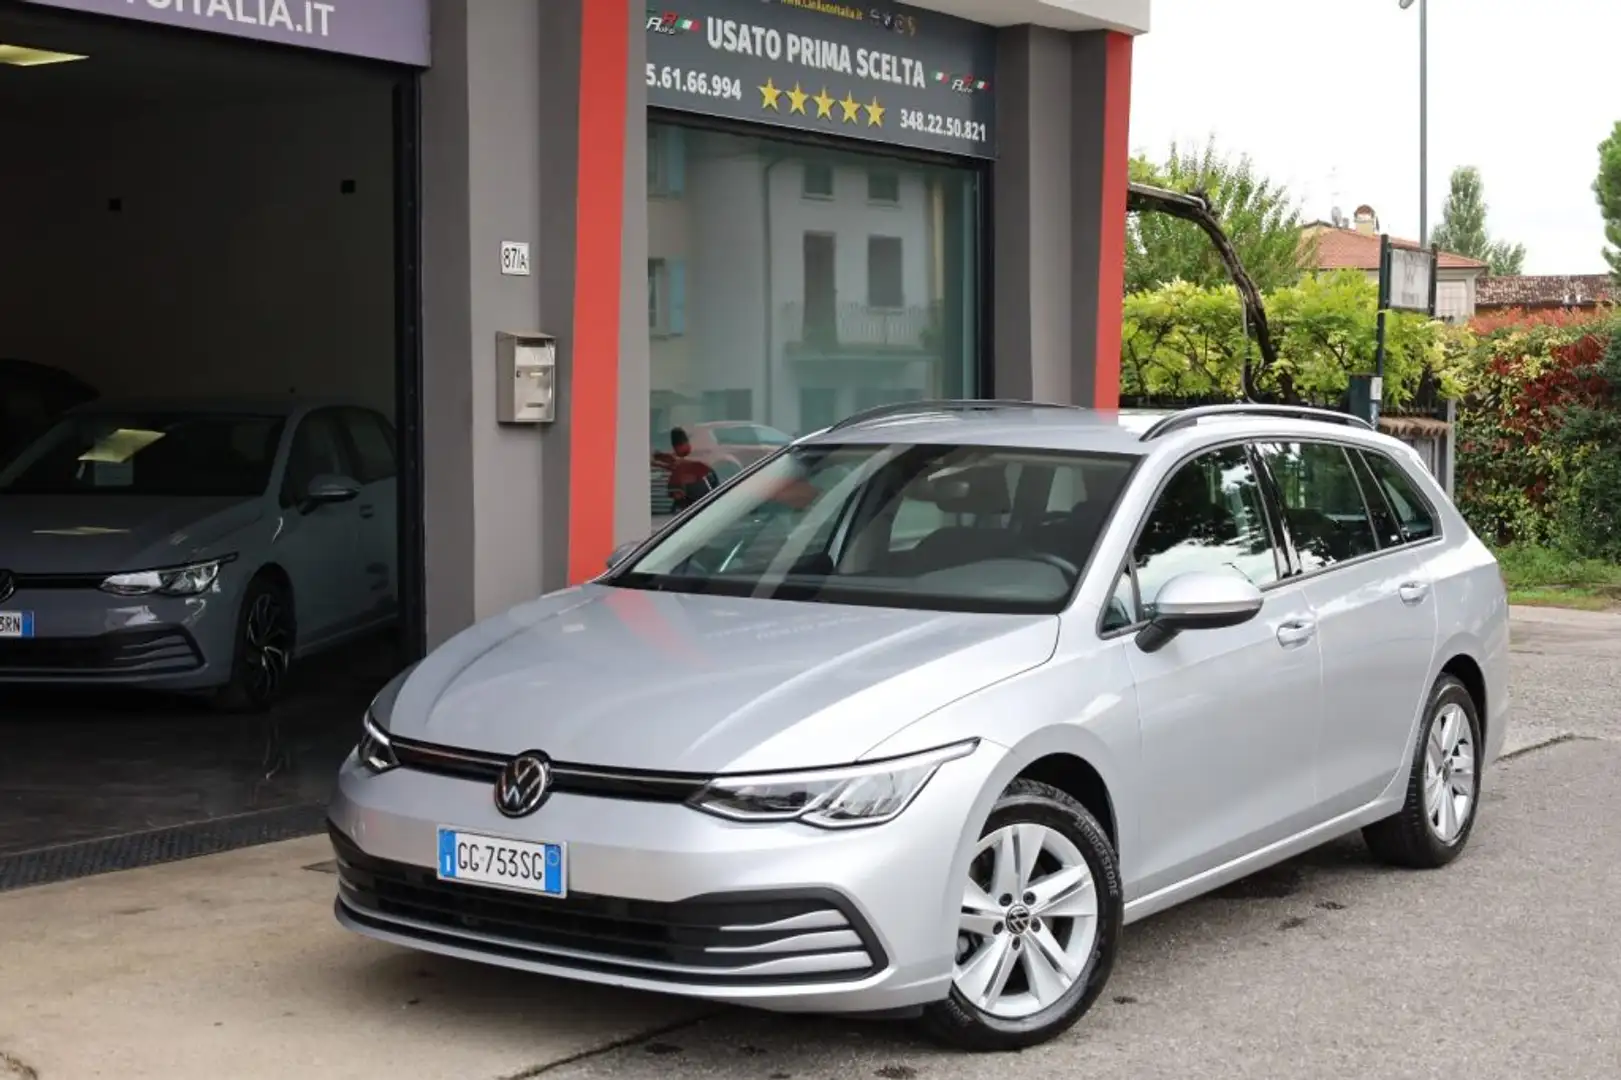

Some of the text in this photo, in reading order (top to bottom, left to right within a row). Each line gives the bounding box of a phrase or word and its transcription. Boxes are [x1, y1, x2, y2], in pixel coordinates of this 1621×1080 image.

[707, 16, 926, 89] USATO PRIMA SCELTA
[900, 108, 986, 142] 348.22.50.821
